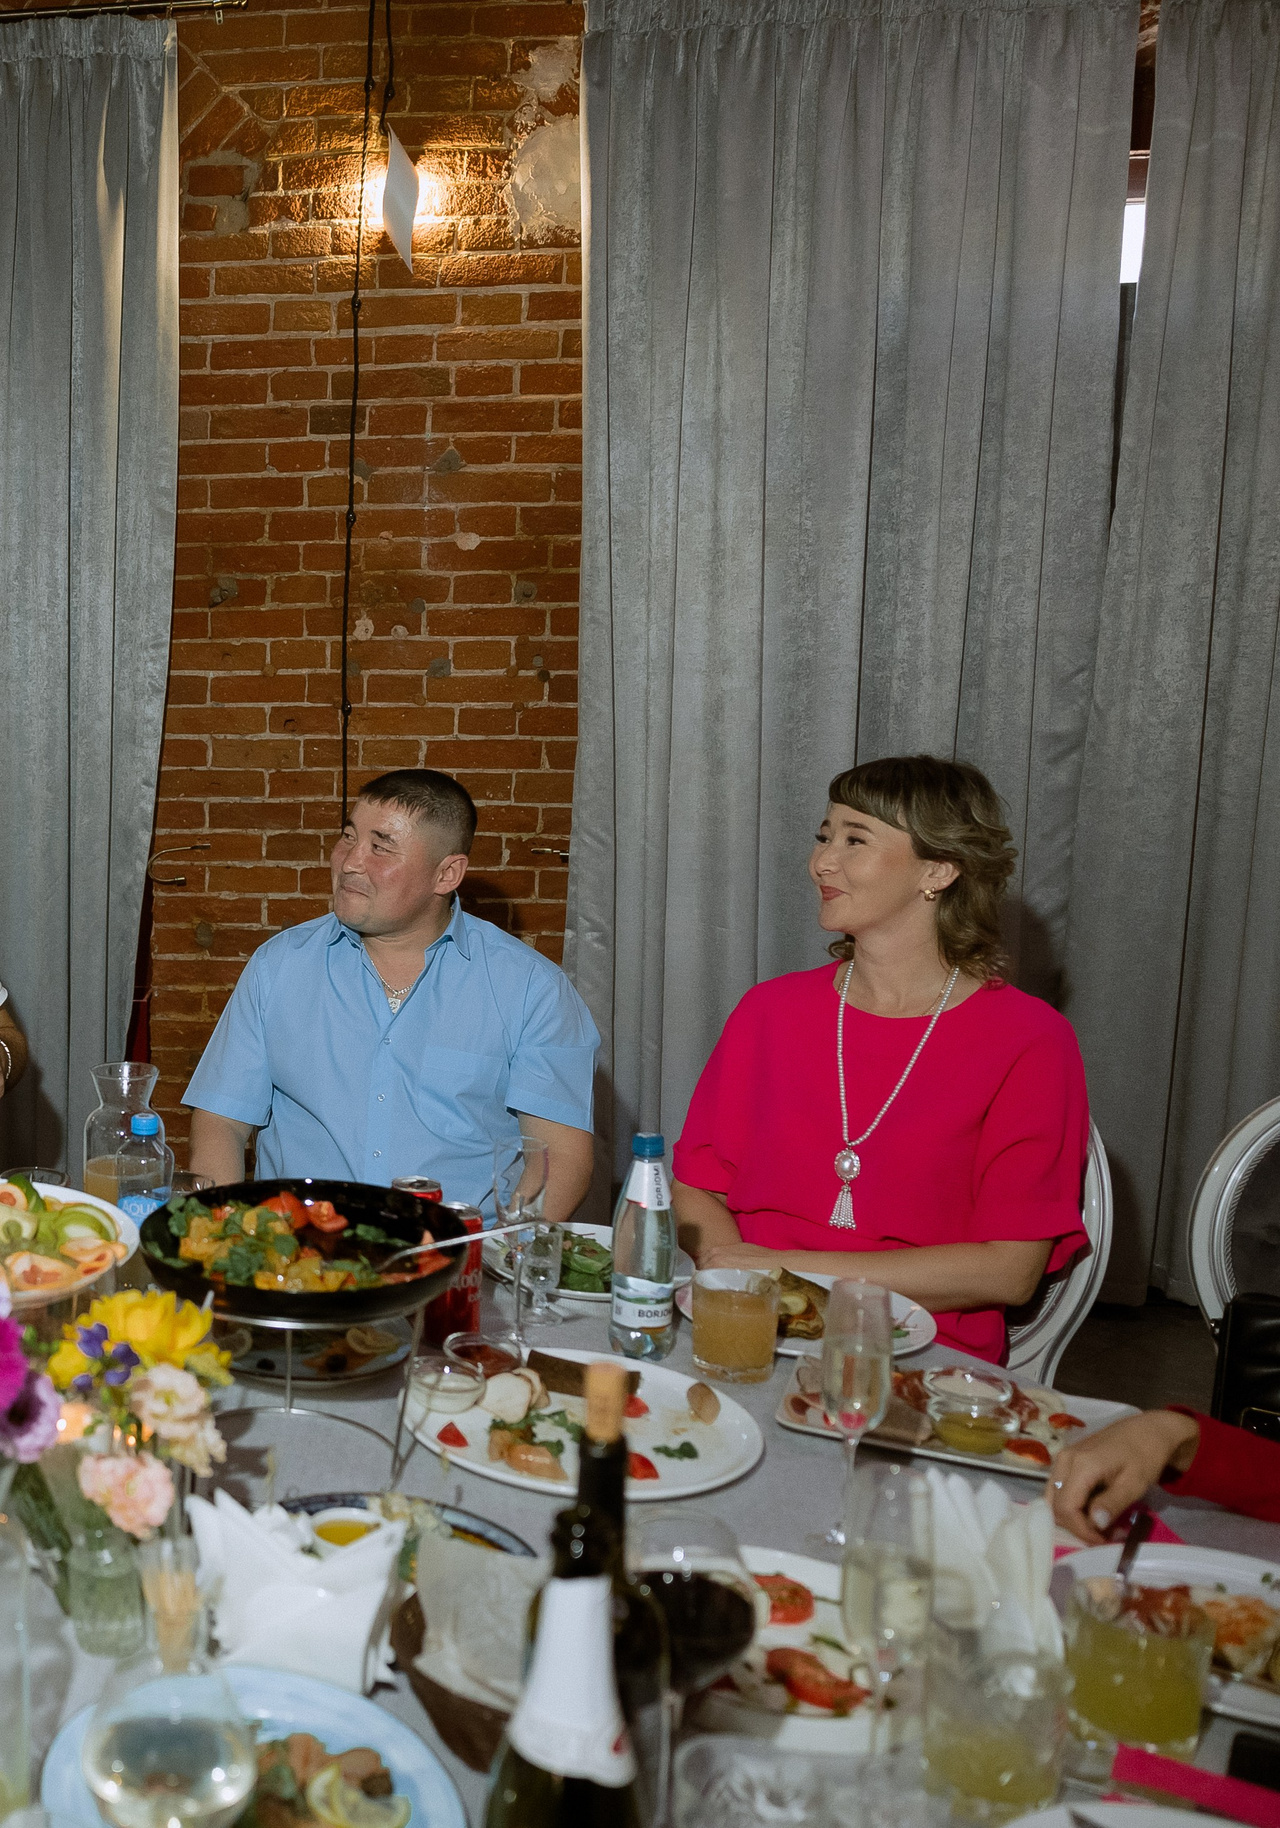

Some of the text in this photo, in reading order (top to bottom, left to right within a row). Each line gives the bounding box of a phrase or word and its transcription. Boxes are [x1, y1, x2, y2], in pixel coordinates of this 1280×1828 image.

[653, 1165, 664, 1206] BORJOMI
[122, 1200, 158, 1216] AQUA
[637, 1308, 673, 1319] BORJO
